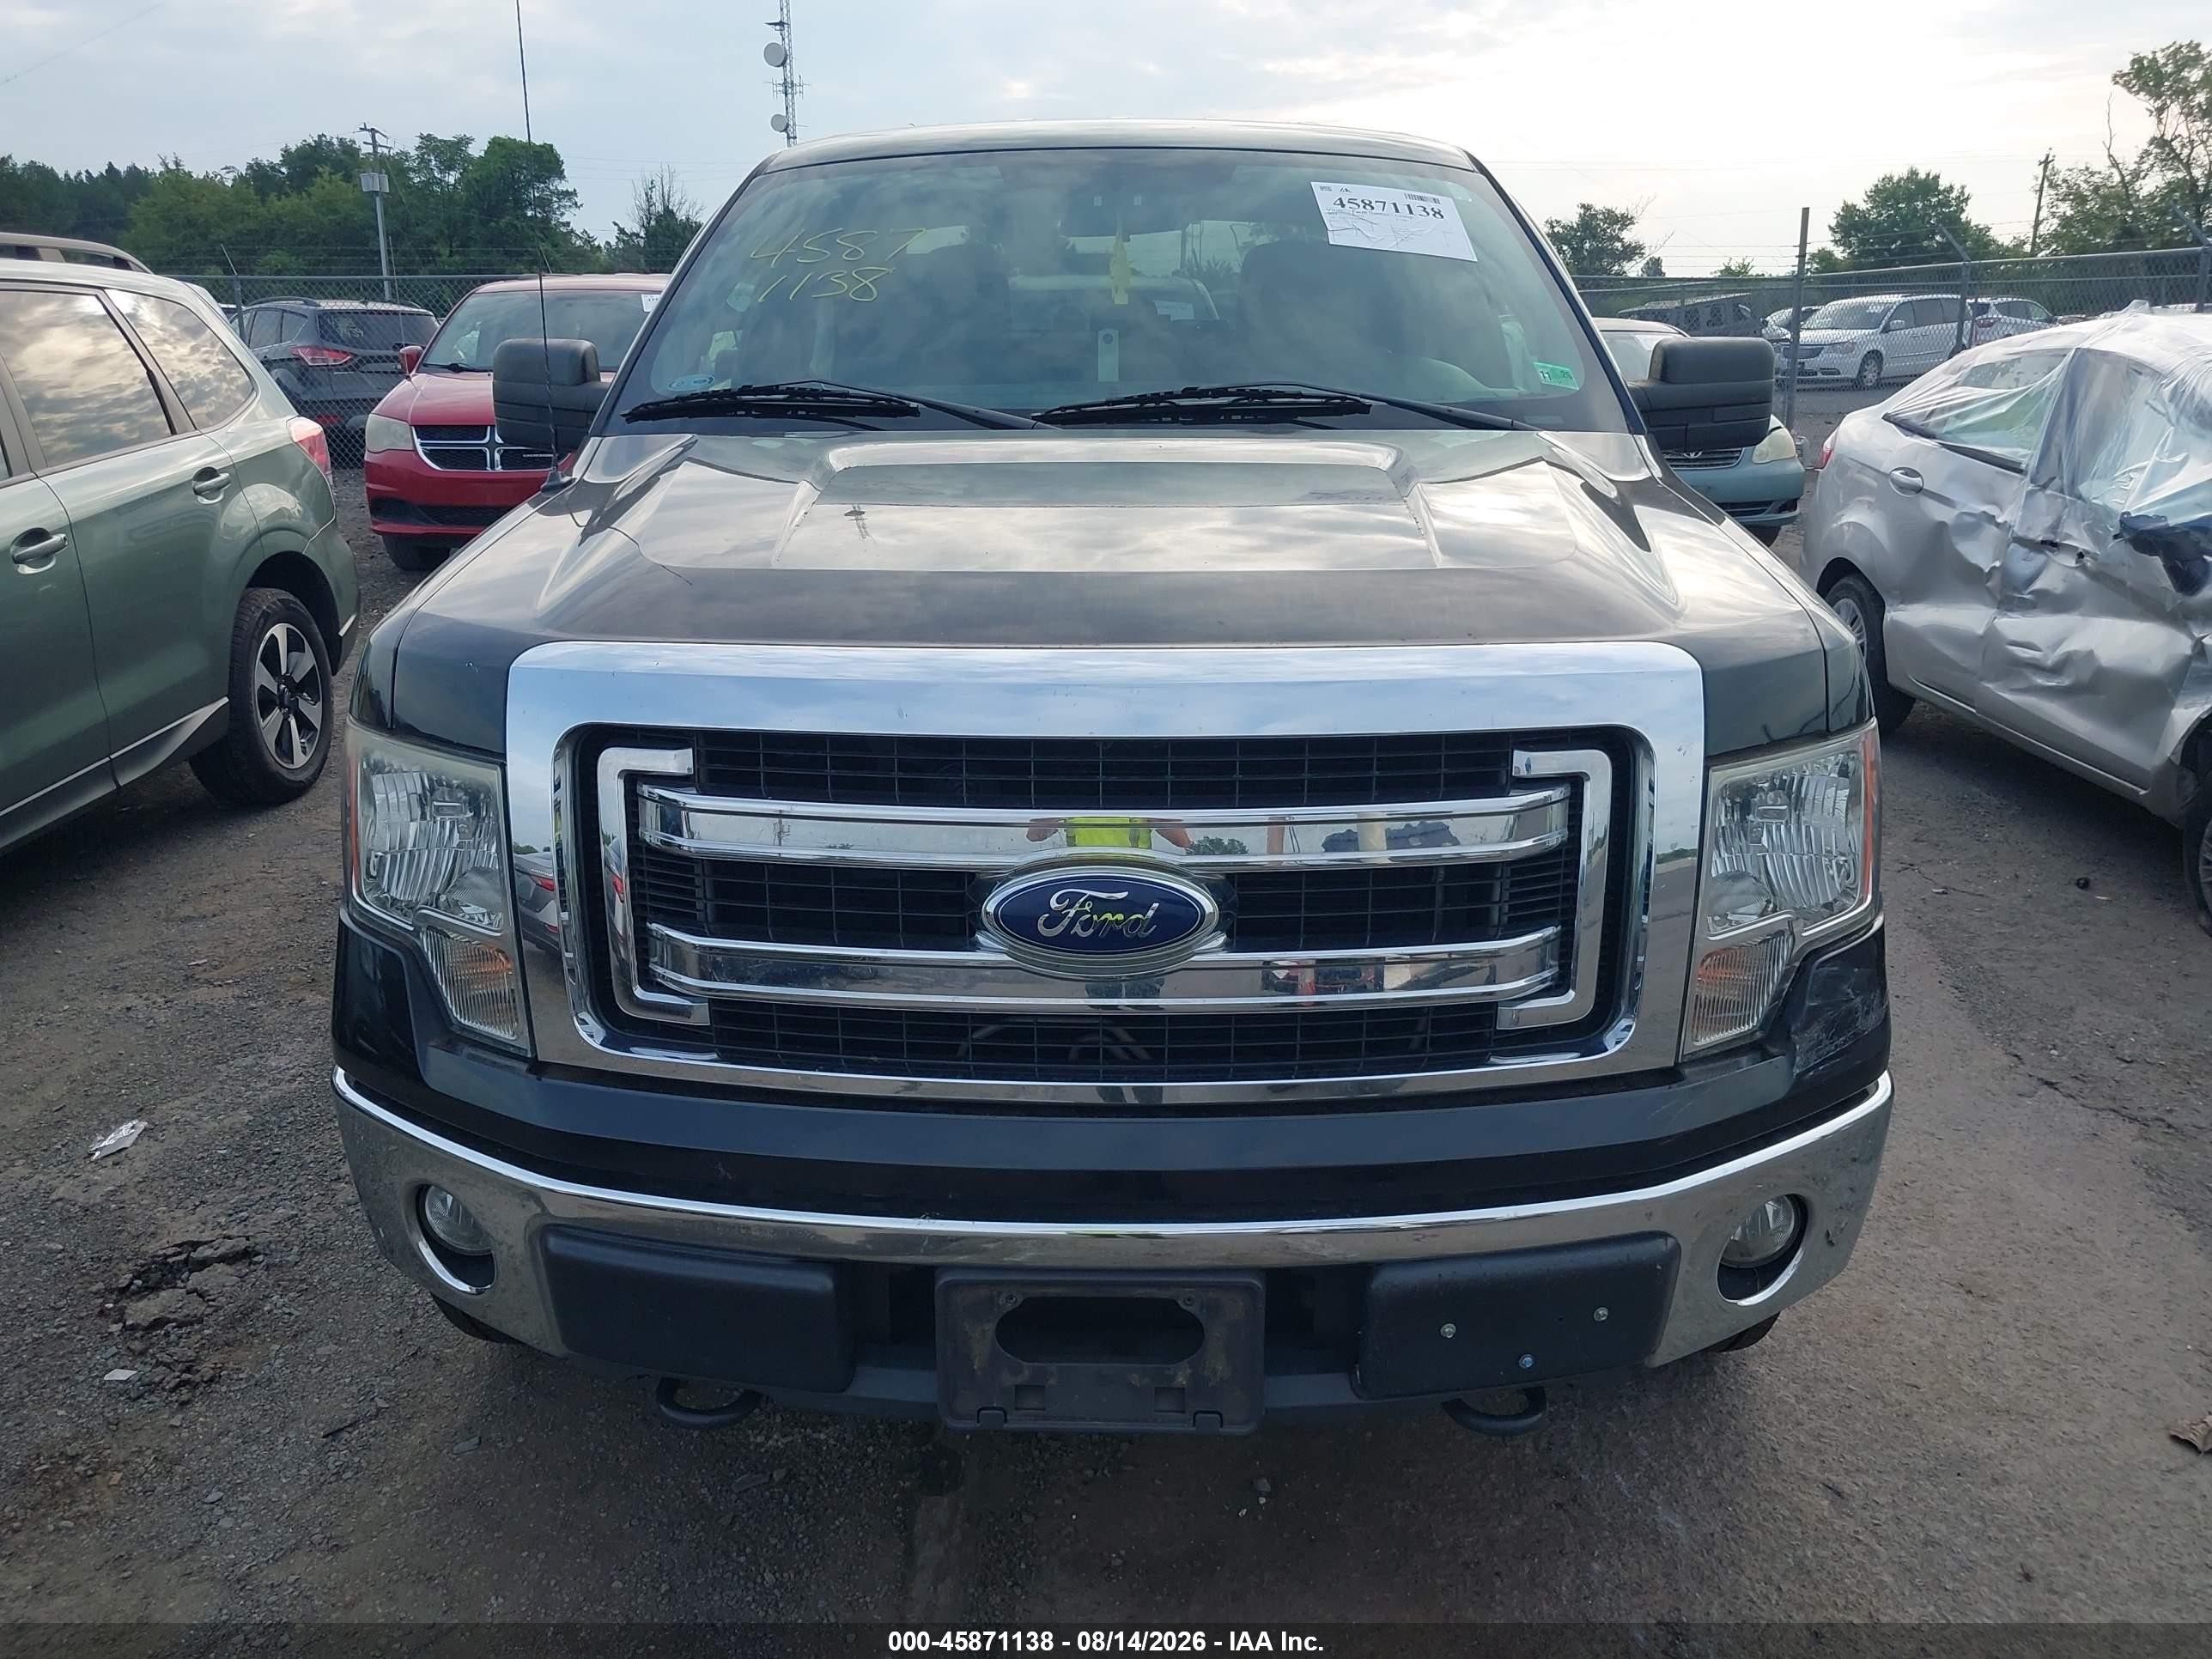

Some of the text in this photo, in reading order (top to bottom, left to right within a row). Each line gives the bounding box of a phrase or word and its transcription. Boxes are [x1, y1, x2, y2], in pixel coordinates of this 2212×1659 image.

[1333, 197, 1444, 220] 45871138
[750, 227, 927, 268] 4587
[758, 266, 896, 302] 1138
[1037, 888, 1159, 938] Ford
